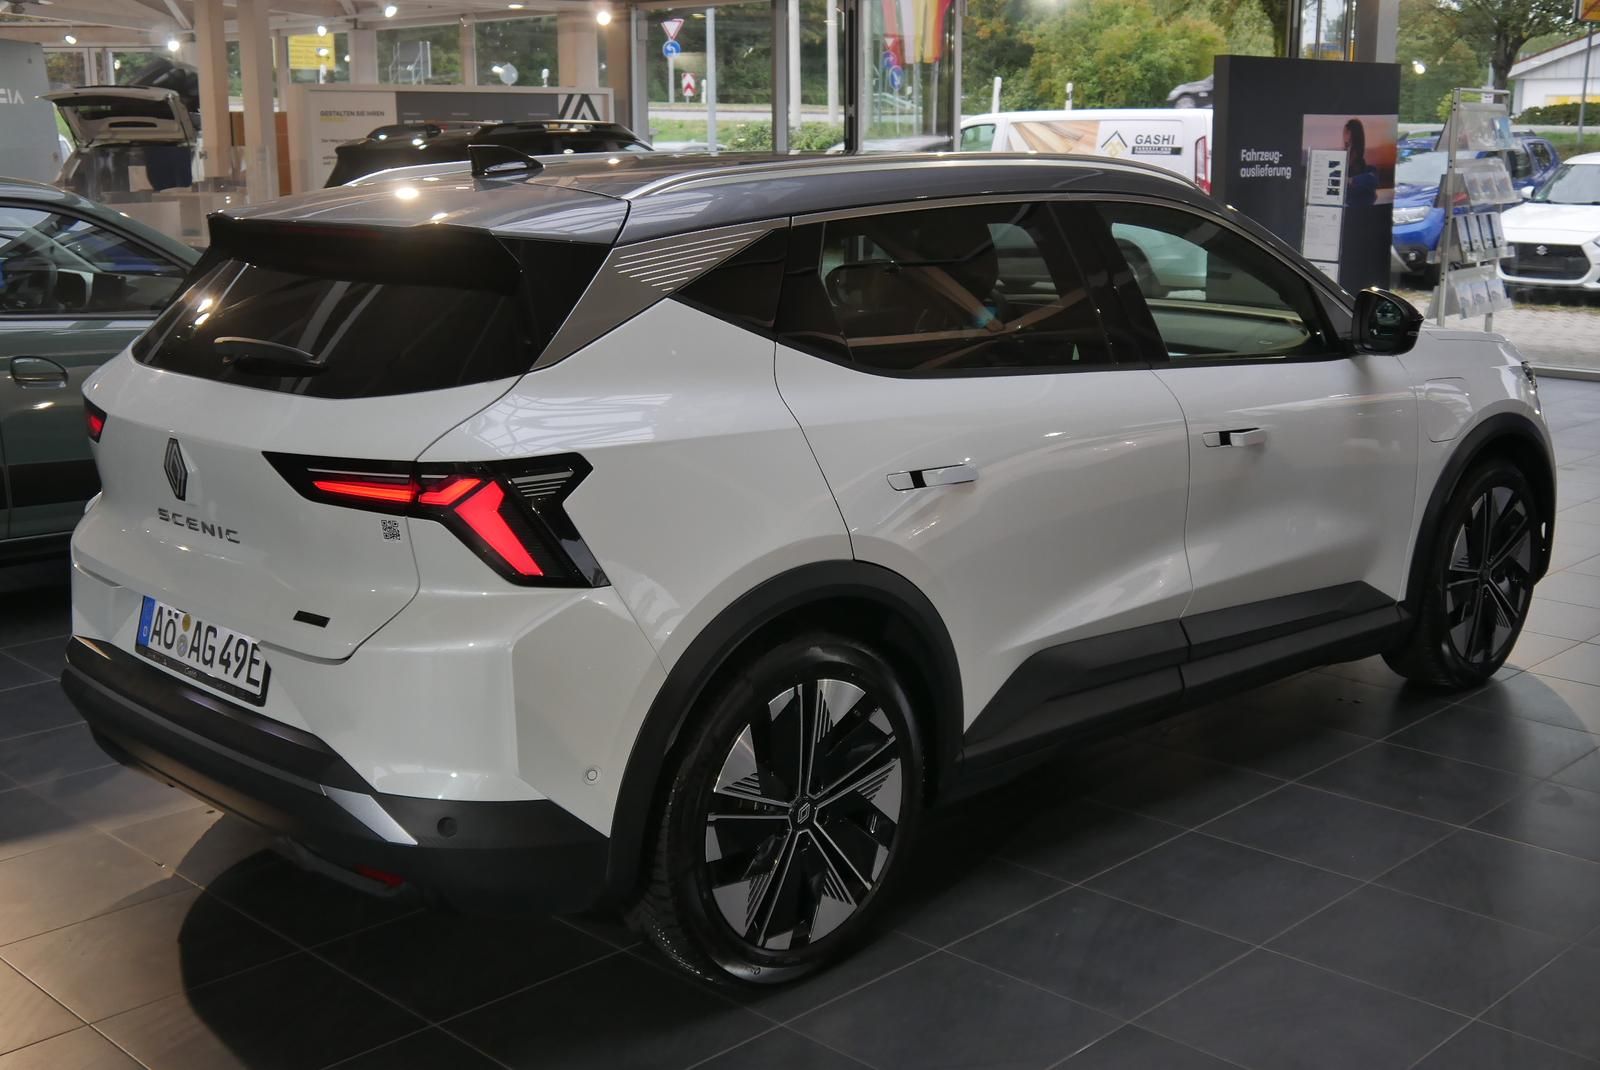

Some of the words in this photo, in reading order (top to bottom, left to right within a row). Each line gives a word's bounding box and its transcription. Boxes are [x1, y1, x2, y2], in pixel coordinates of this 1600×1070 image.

[1135, 134, 1176, 145] GASHI
[1240, 148, 1284, 164] Fahrzeug-
[1240, 164, 1292, 180] auslieferung
[158, 507, 241, 544] SCENIC
[150, 606, 179, 650] AÖ
